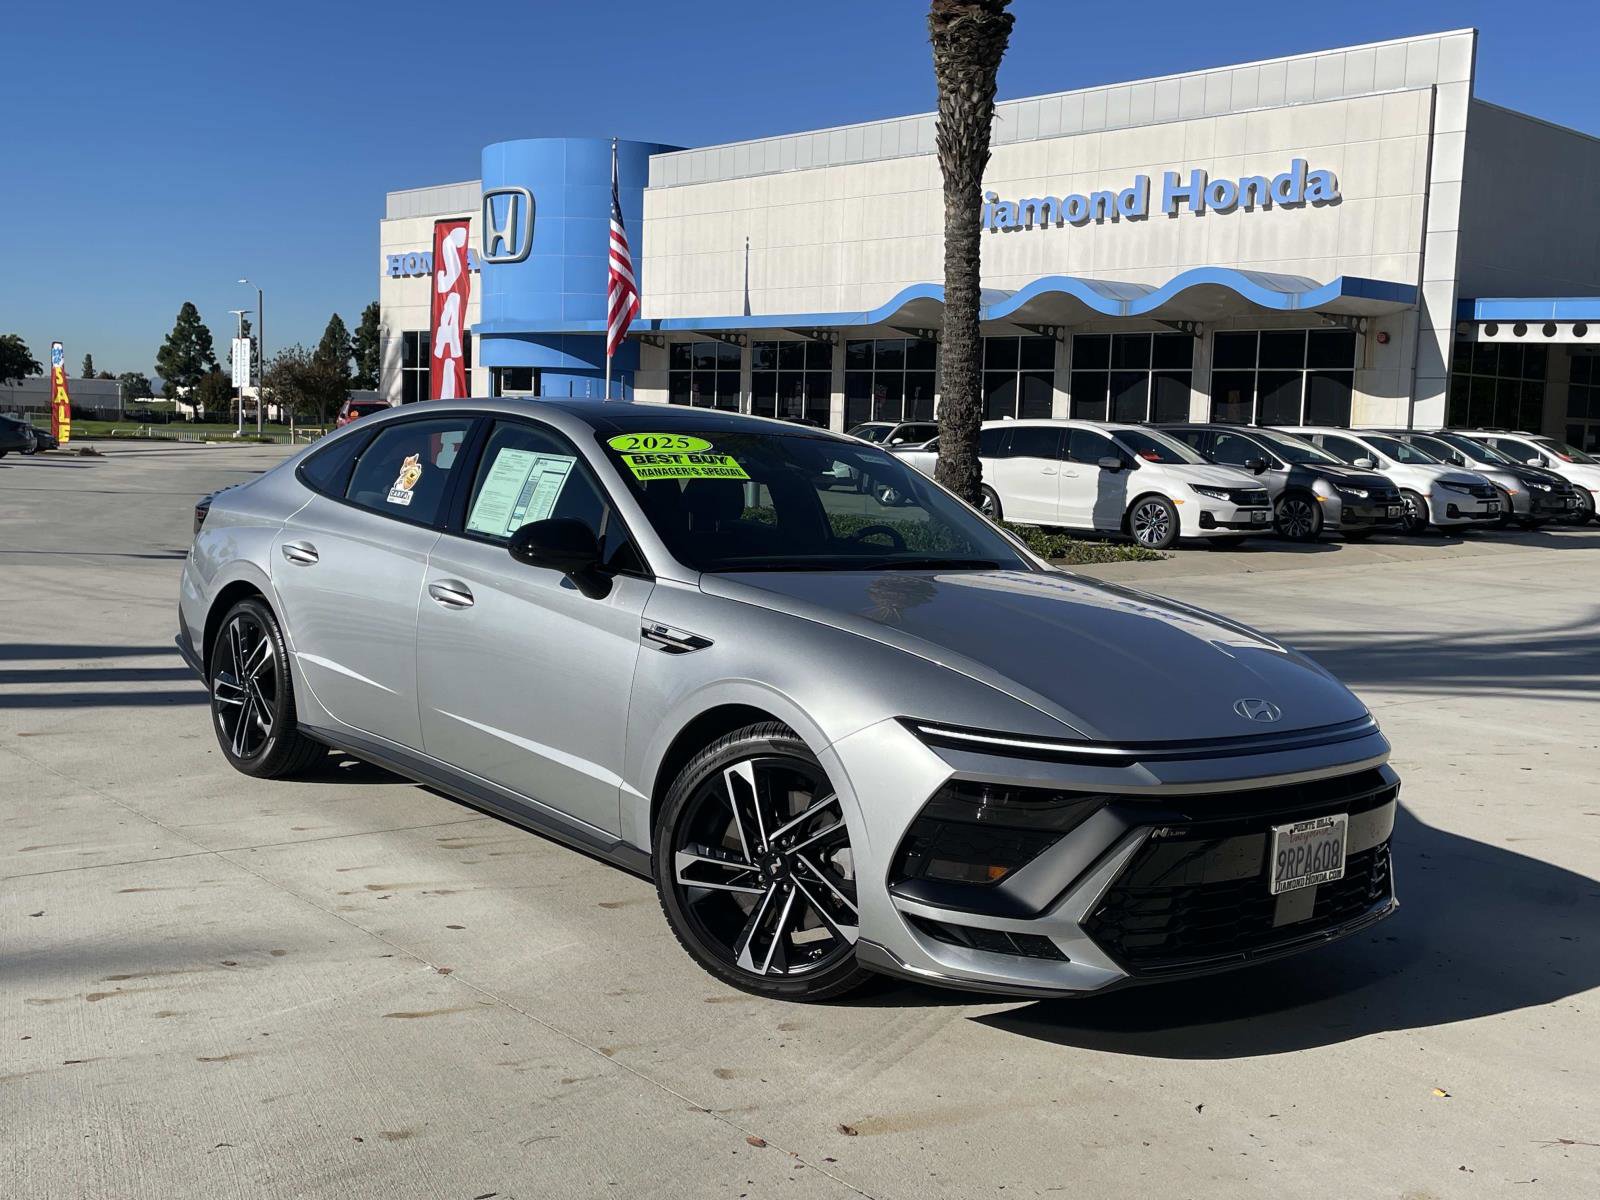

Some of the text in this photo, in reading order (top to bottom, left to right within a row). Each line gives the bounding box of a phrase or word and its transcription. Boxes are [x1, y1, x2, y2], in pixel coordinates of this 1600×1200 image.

[981, 157, 1338, 230] iamond Honda
[386, 248, 481, 277] HONA
[53, 366, 70, 443] SALE
[626, 436, 690, 450] 2025
[631, 453, 728, 466] BEST BUY
[637, 467, 746, 478] MANAGER'S SPECIAL
[1275, 838, 1341, 881] 9RPA608
